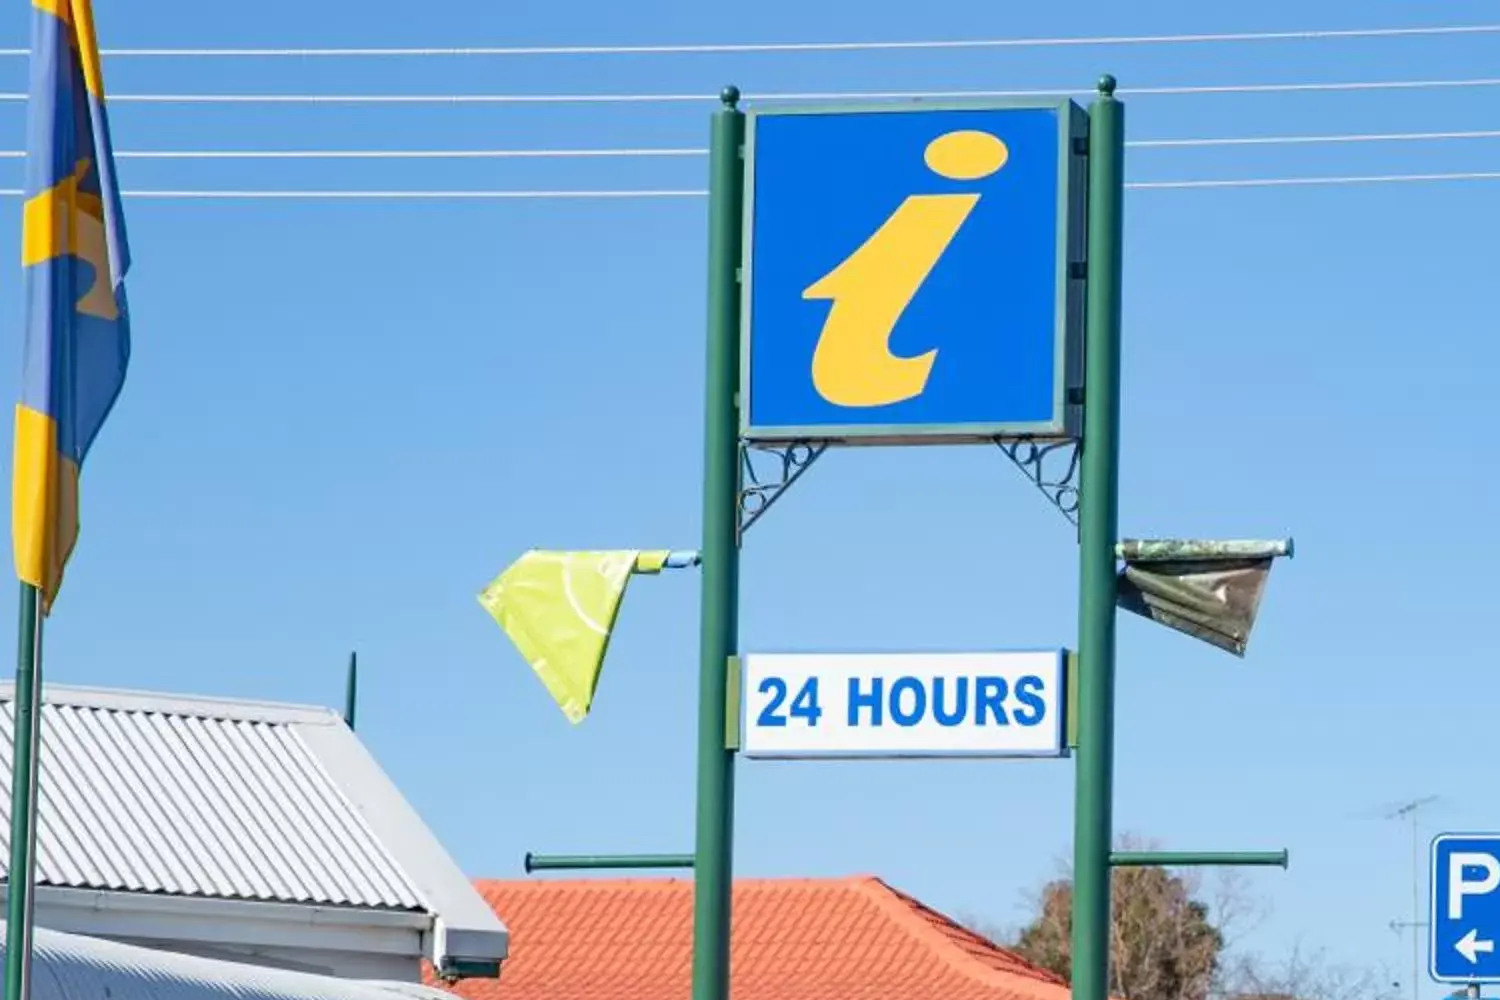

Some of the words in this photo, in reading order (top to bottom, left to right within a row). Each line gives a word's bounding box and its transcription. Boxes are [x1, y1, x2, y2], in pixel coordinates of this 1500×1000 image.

[801, 129, 1009, 408] i
[756, 676, 822, 728] 24
[848, 675, 1047, 728] HOURS
